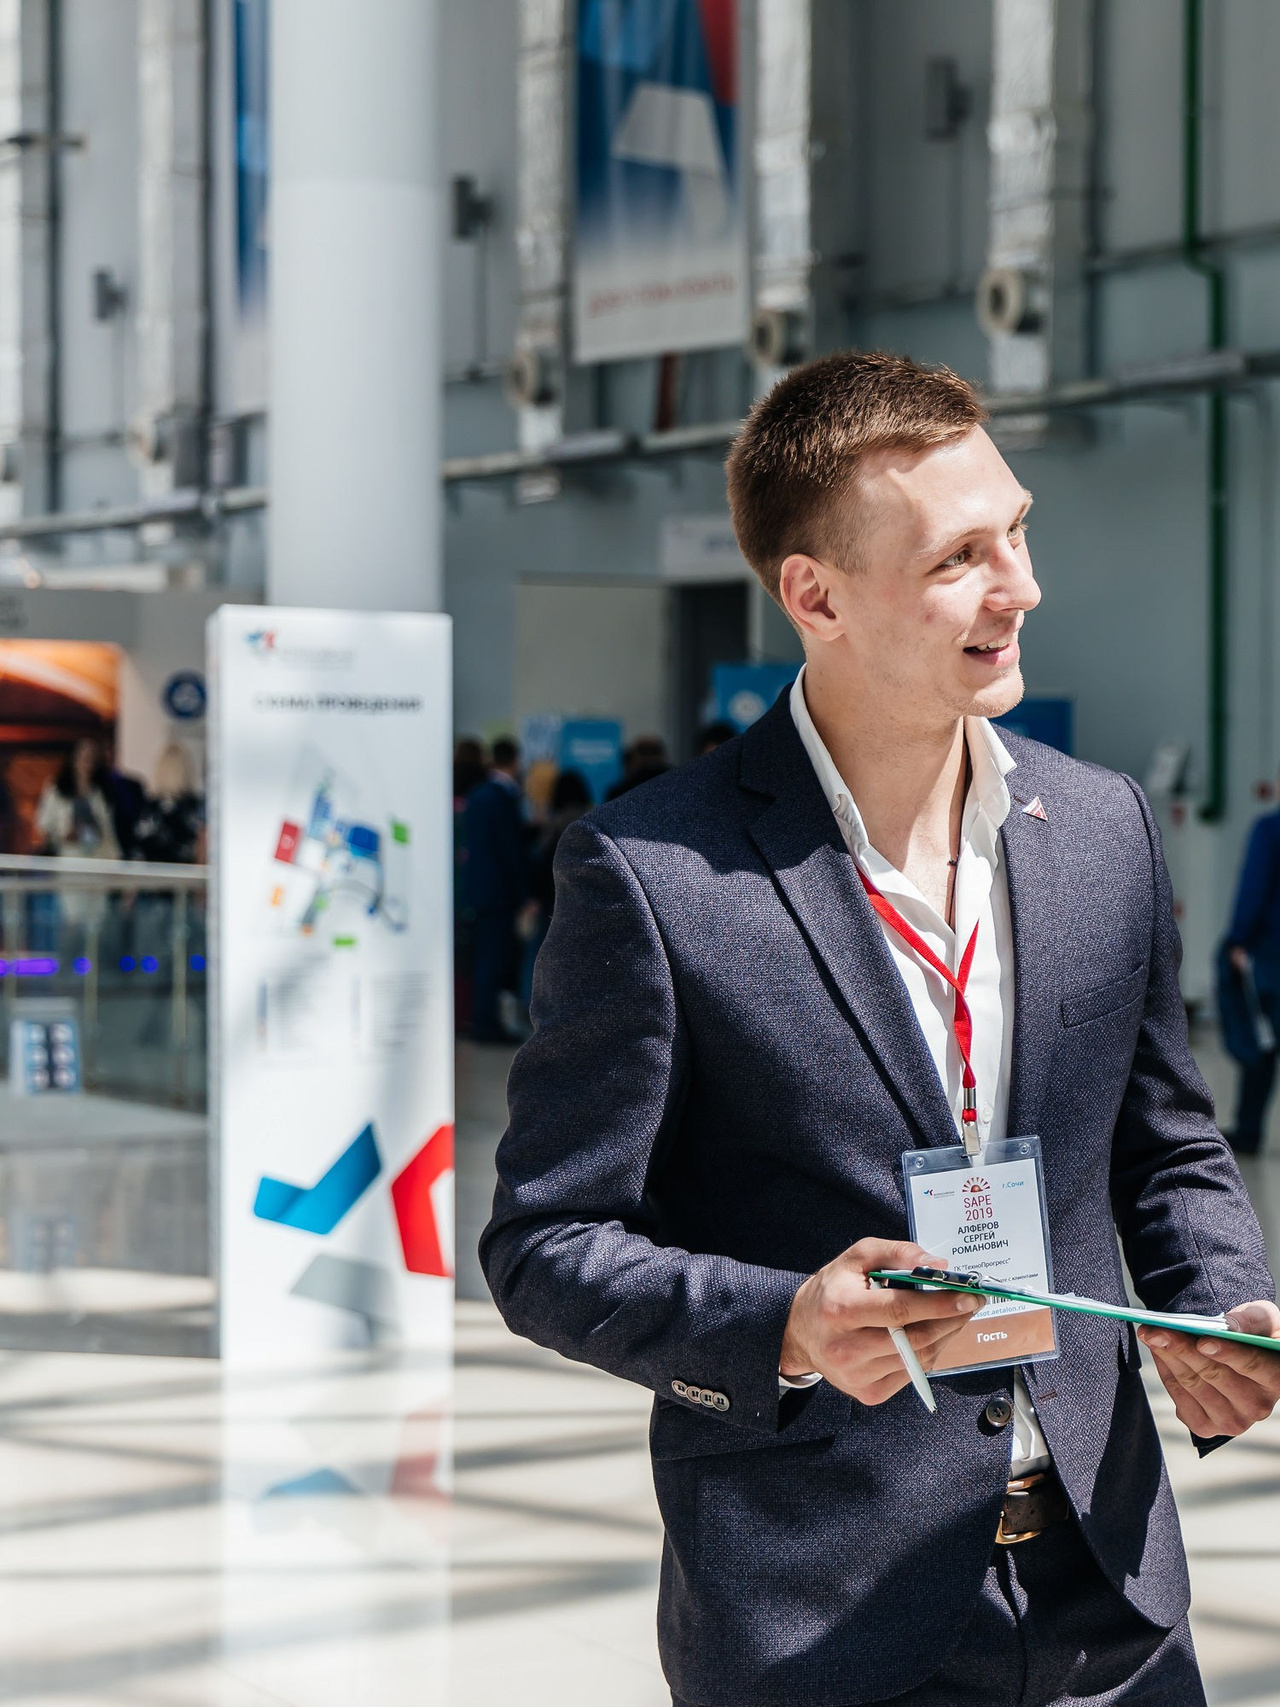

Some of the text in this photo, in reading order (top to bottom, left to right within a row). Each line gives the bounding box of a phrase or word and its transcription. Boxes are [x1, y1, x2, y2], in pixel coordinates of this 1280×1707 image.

[963, 1194, 992, 1209] SAPE
[965, 1207, 993, 1221] 2019
[957, 1221, 1000, 1235] АЛФЕРОВ
[963, 1230, 996, 1244] СЕРГЕЙ
[952, 1239, 1009, 1255] РОМАНОВИЧ
[962, 1258, 1011, 1270] "ТехноПрогресс"
[975, 1305, 1026, 1318] ssot.aetalon.ru
[977, 1331, 1008, 1342] Гость
